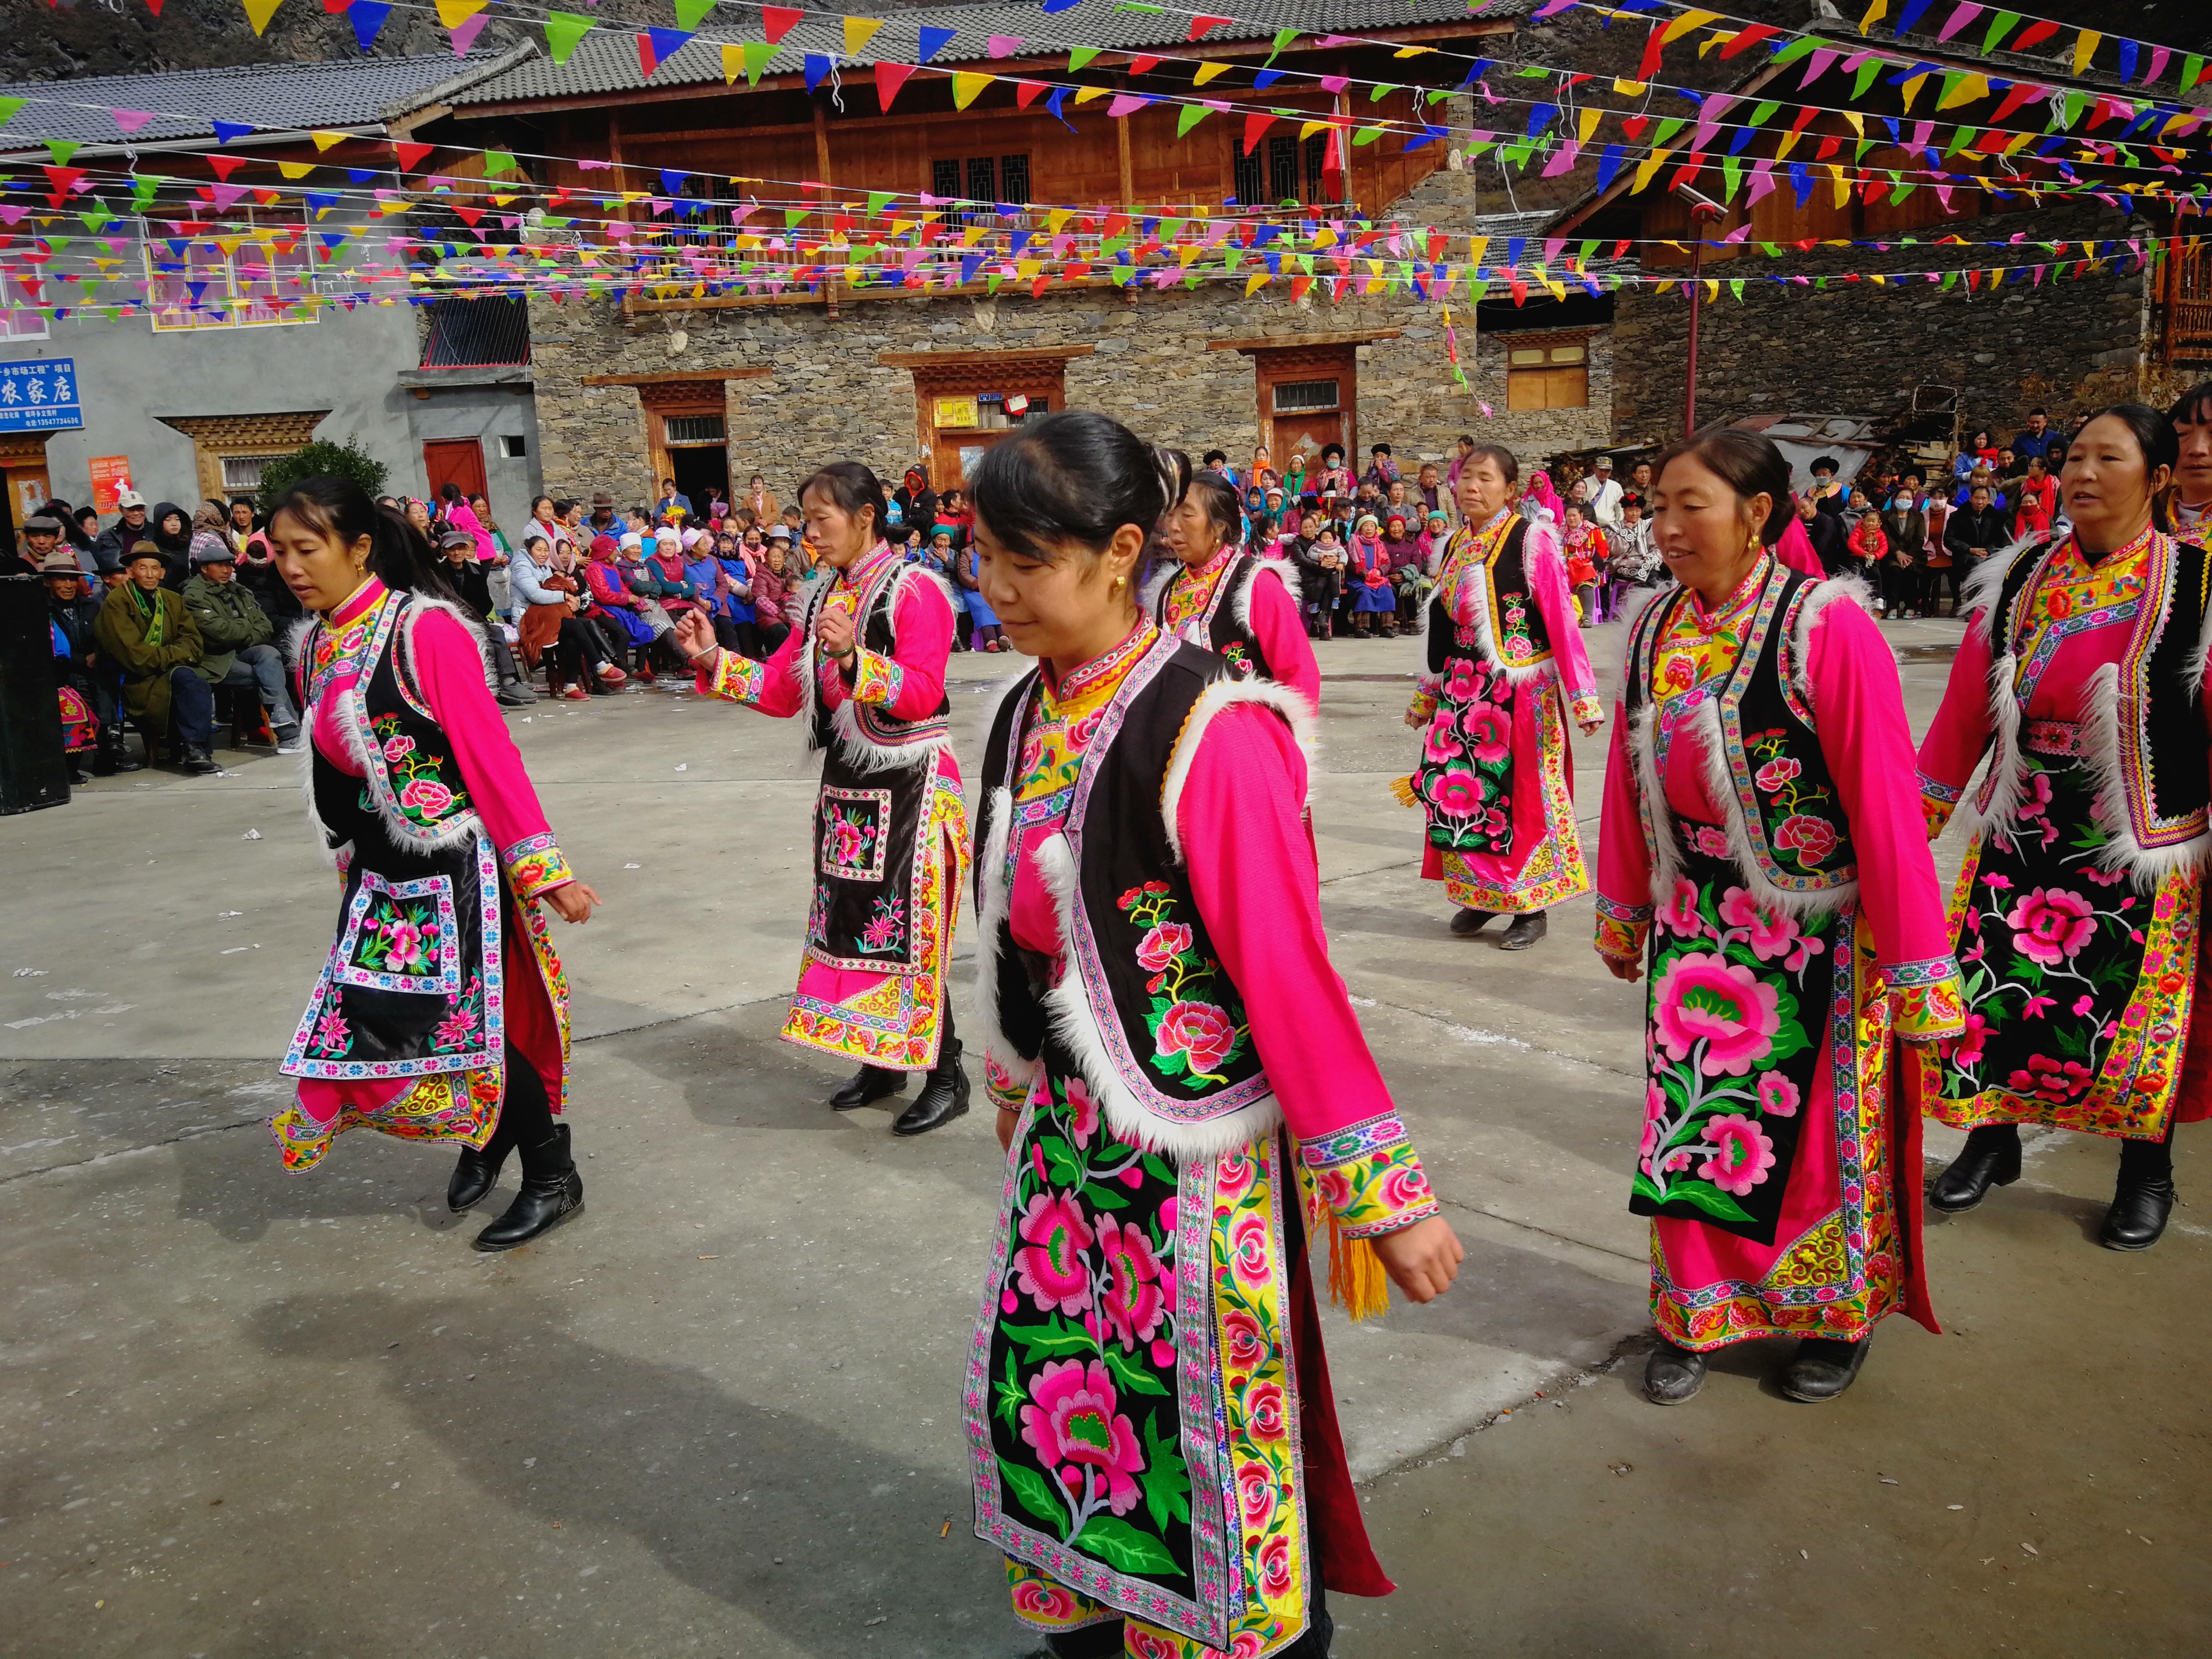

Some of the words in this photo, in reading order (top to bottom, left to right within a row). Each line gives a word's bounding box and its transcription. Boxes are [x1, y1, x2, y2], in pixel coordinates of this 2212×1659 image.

[0, 365, 50, 376] 乡市场工程”
[54, 363, 71, 373] 项目
[1, 376, 71, 405] 农家店
